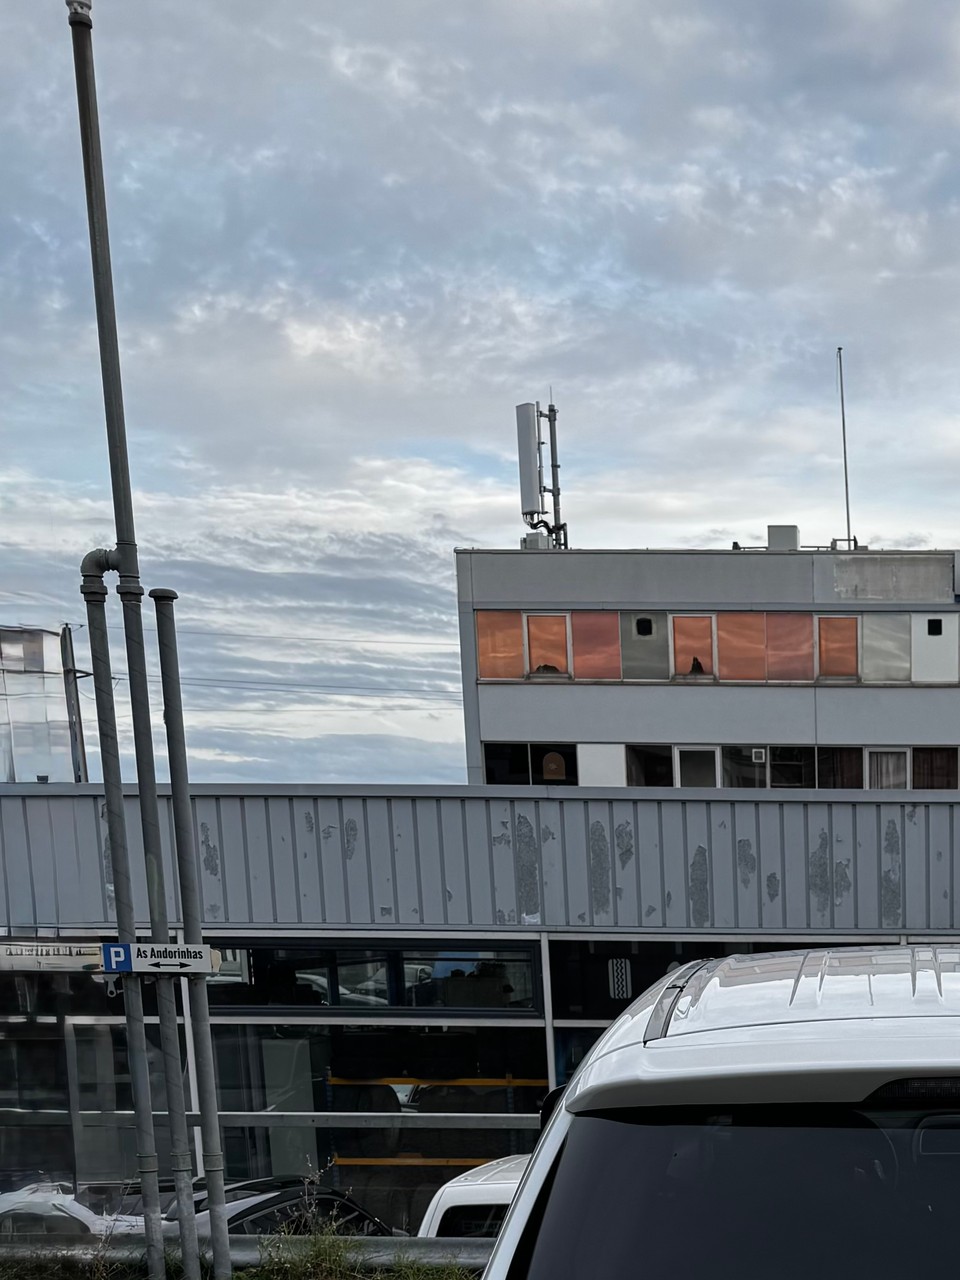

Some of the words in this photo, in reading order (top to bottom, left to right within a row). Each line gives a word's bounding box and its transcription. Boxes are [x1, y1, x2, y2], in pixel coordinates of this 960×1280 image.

[110, 947, 125, 969] P
[136, 947, 148, 959] As
[150, 947, 203, 960] Andorinhas
